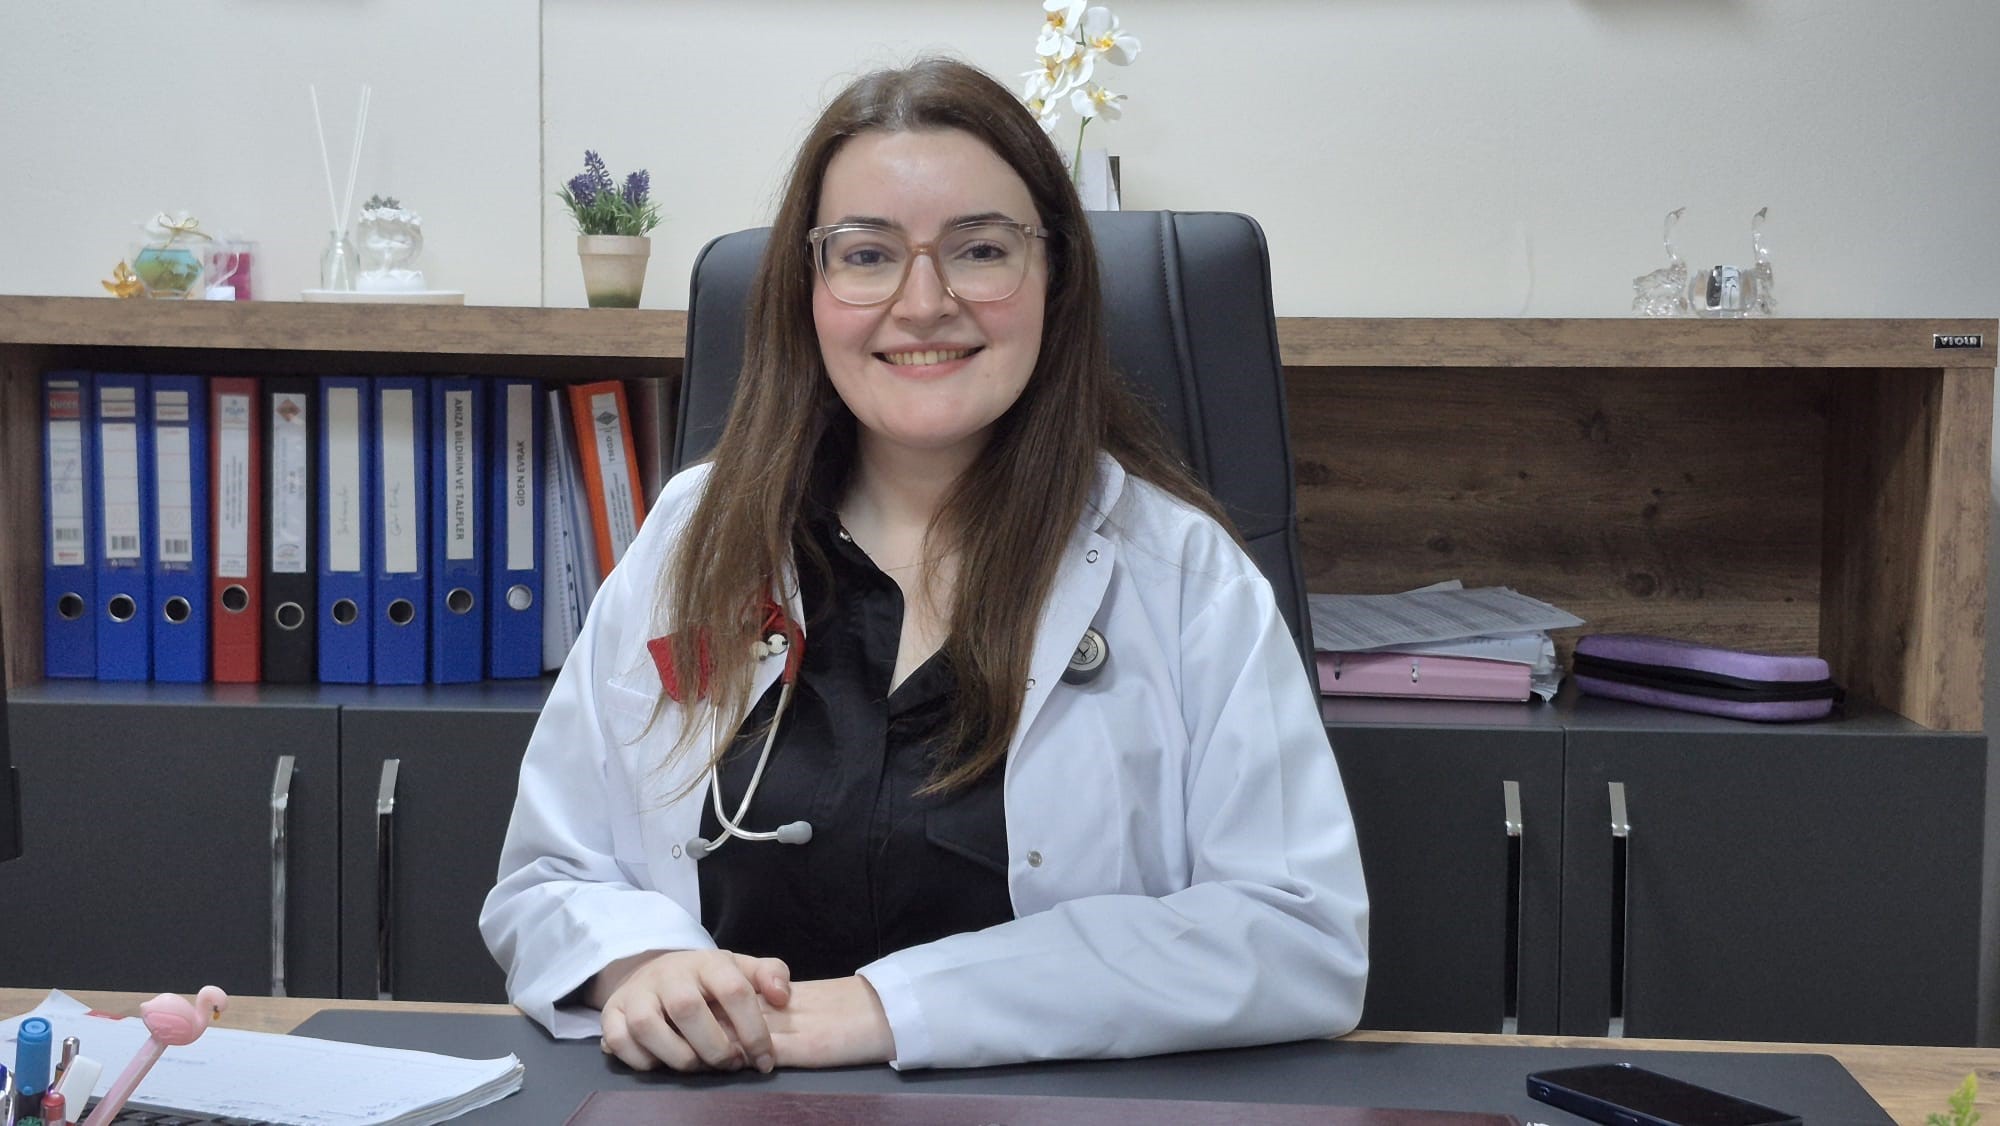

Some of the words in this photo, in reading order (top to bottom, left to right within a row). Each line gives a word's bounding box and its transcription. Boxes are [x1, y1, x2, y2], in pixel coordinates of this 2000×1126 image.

[454, 397, 464, 429] ARIZA
[516, 440, 526, 473] EVRAK
[455, 478, 465, 490] VE
[515, 475, 526, 508] GİDEN
[455, 494, 465, 541] TALEPLER
